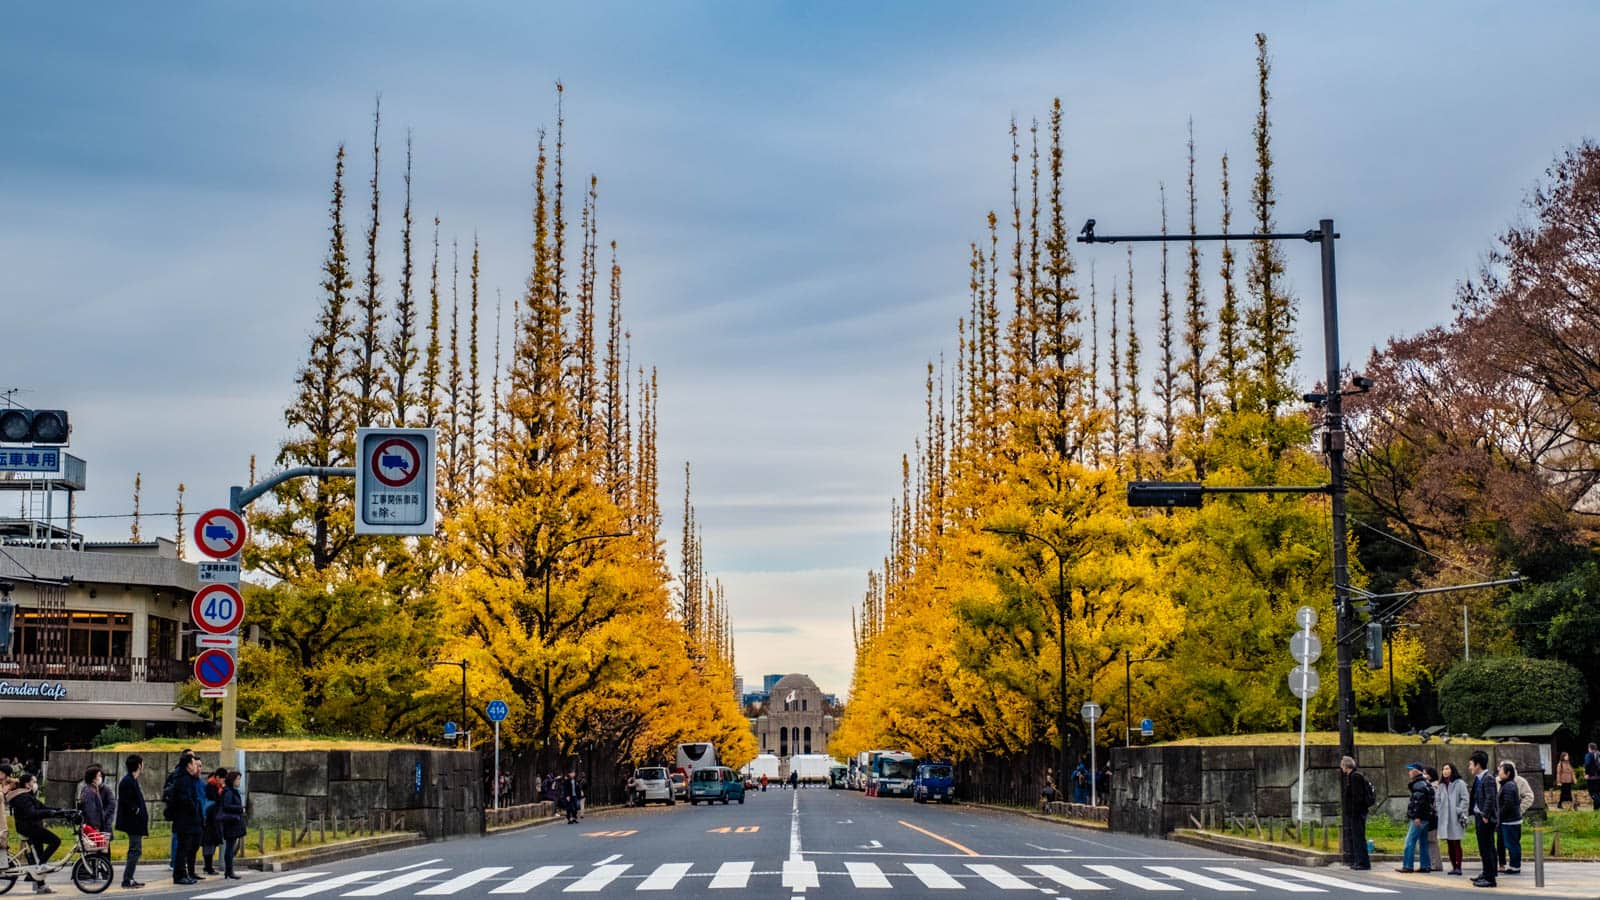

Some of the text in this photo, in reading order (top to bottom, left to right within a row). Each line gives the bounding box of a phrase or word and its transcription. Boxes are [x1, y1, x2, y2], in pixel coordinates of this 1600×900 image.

[371, 494, 419, 505] 工事関係車両
[204, 598, 233, 620] 40
[0, 681, 66, 700] Garden Cafe
[489, 706, 505, 715] 414
